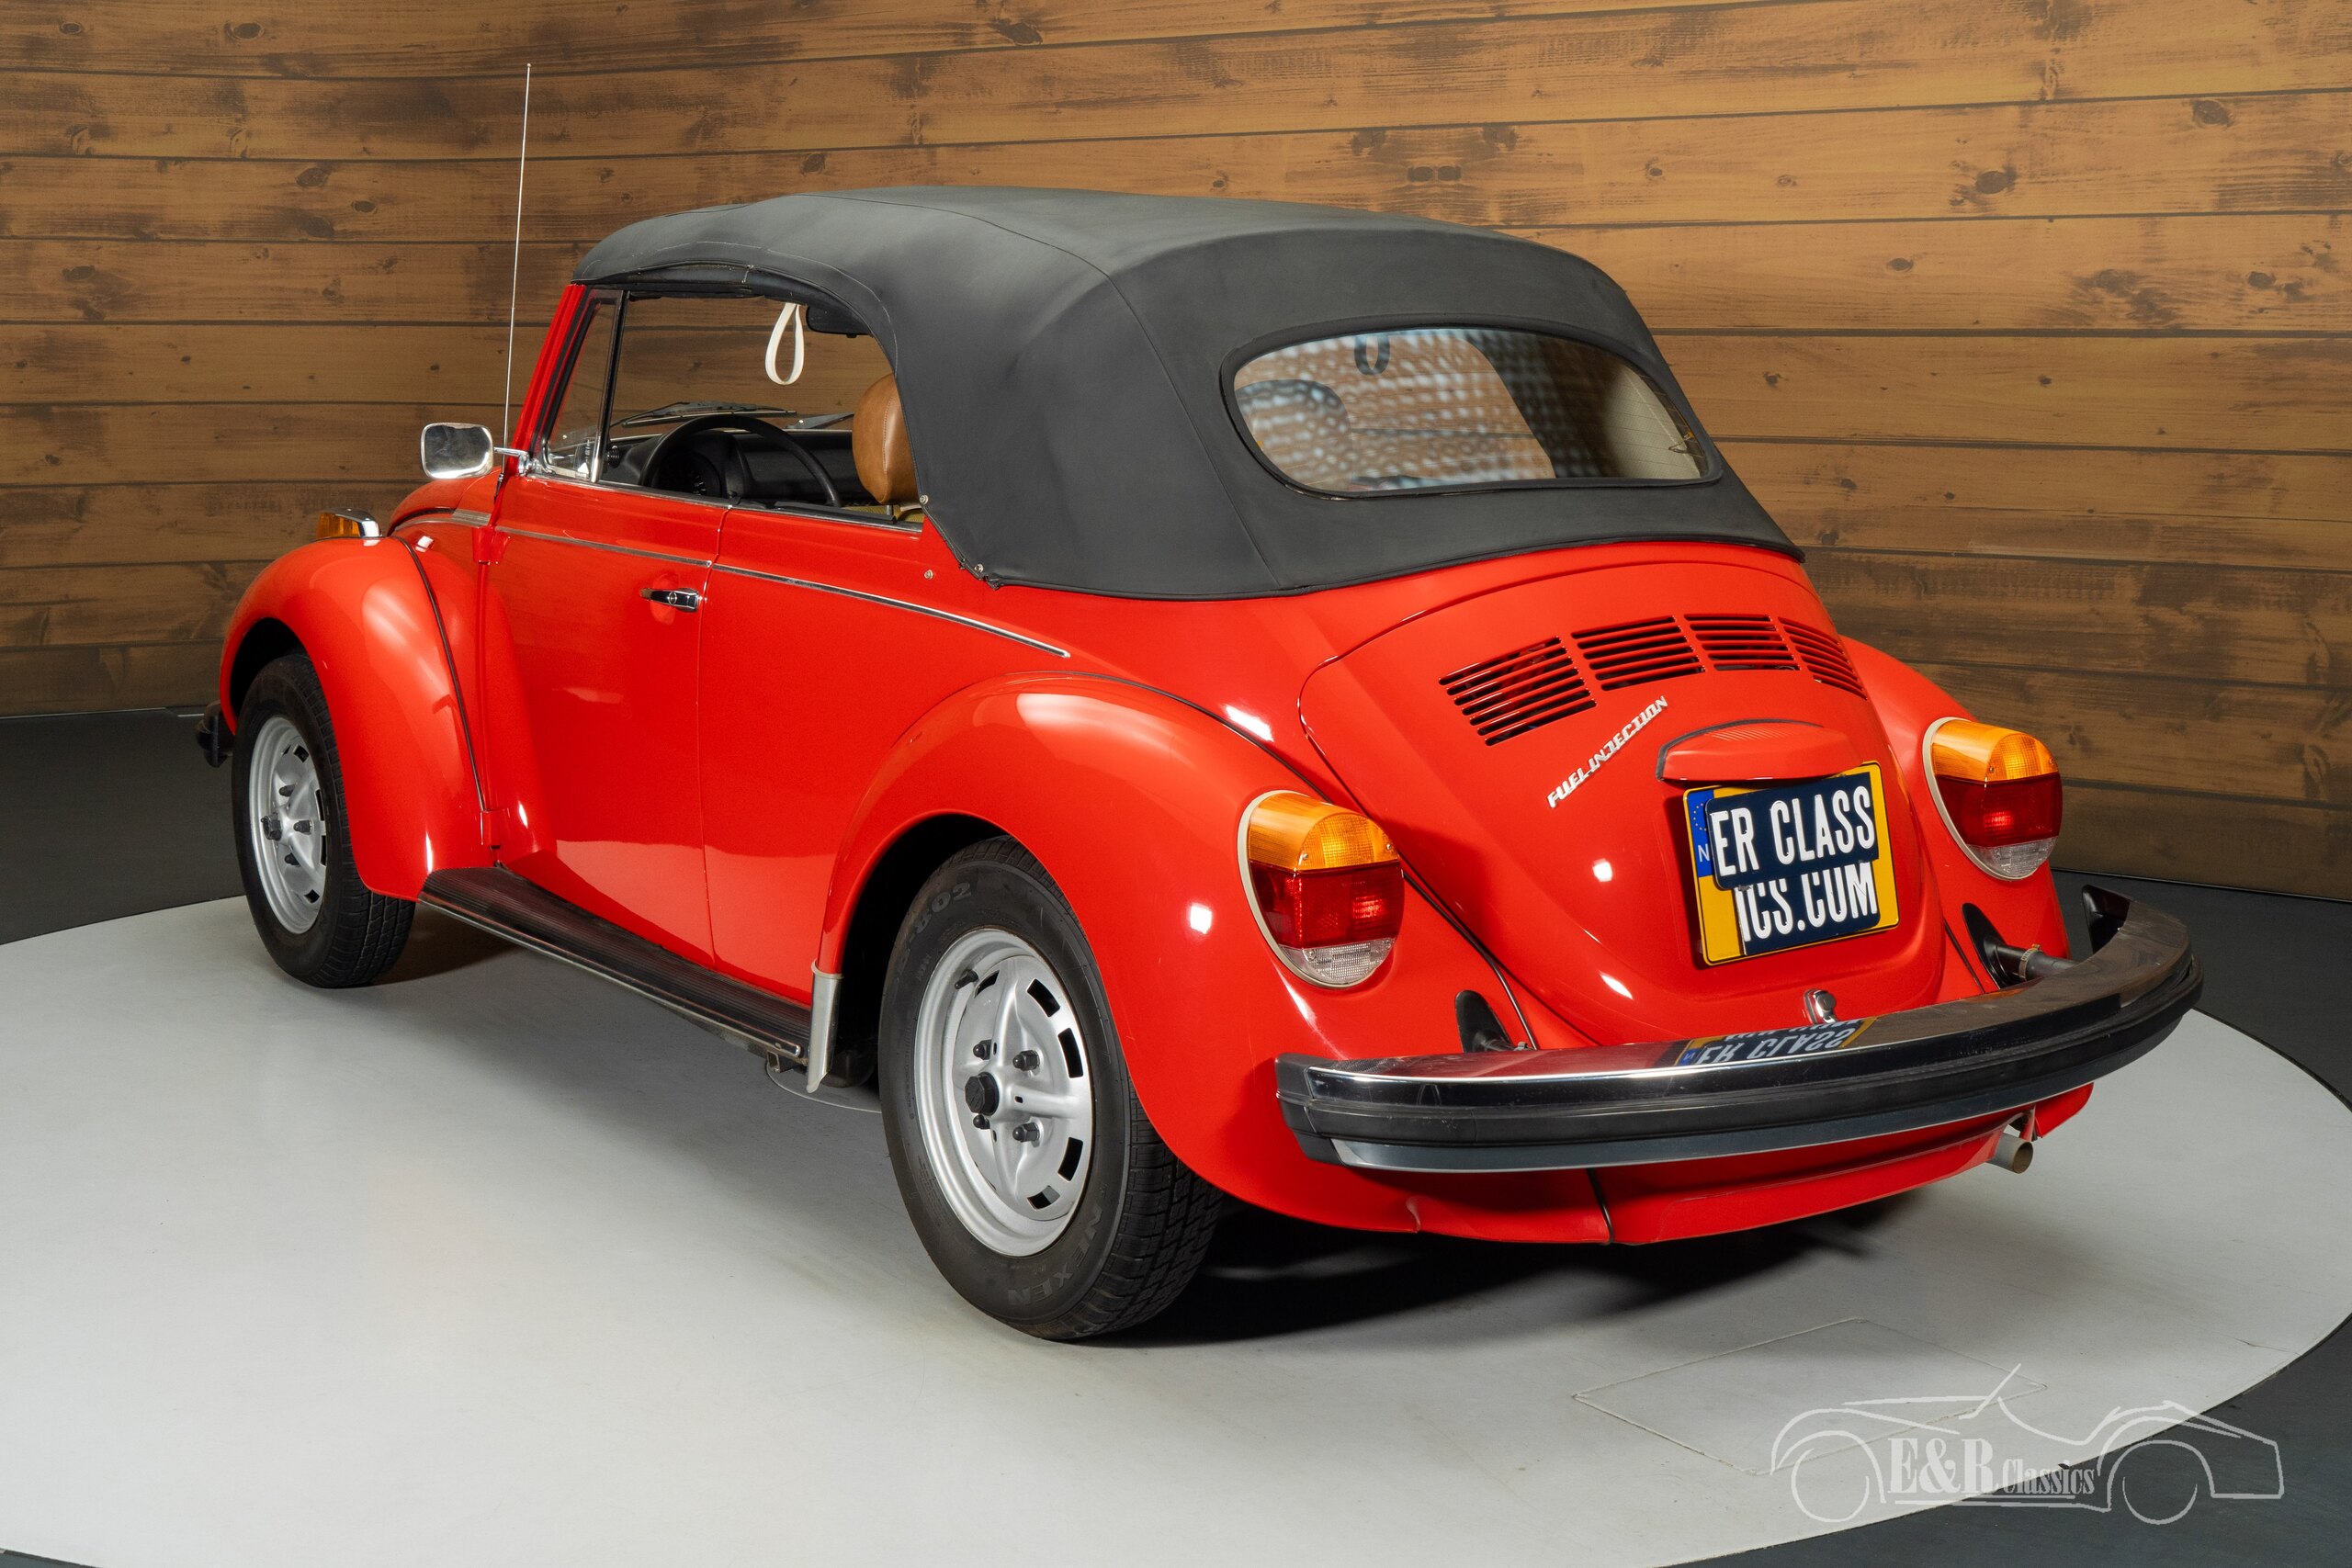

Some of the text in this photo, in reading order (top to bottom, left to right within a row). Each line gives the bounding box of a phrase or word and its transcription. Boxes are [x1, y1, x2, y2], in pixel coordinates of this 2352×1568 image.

[1547, 695, 1668, 808] FUEL INJECTION
[1710, 785, 1875, 876] ER CLASS
